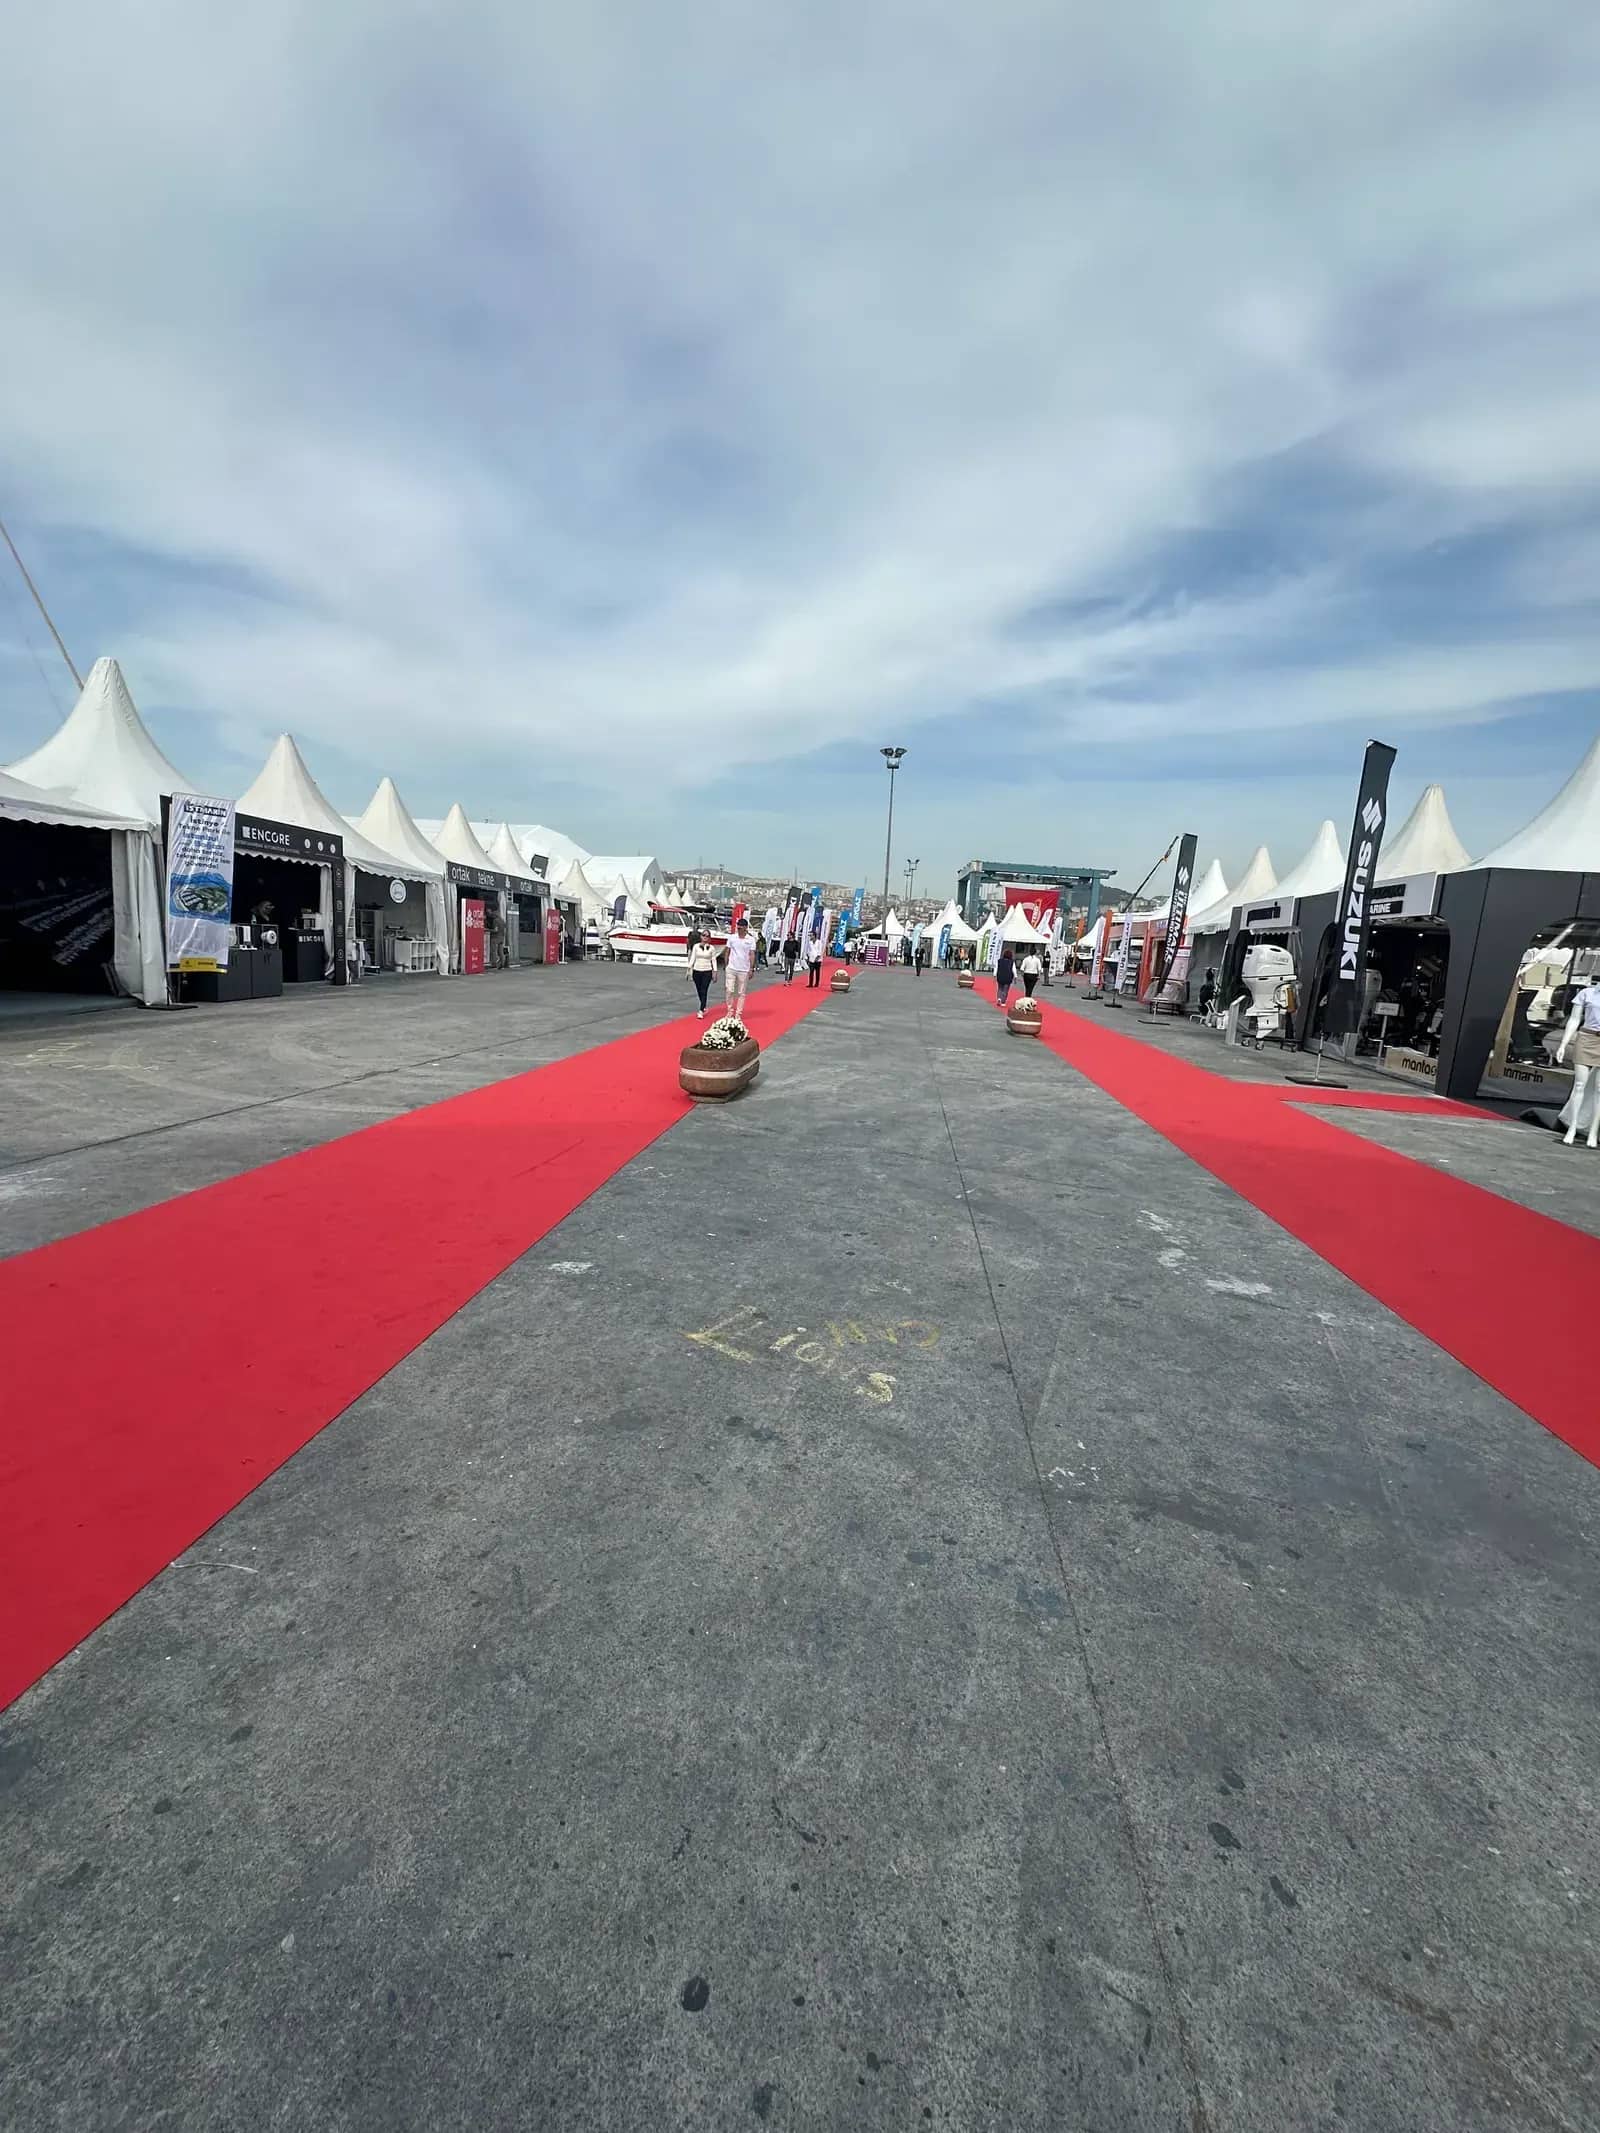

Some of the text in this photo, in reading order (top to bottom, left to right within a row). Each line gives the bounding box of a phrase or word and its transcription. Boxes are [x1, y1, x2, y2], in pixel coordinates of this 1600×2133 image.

[251, 828, 290, 846] ENCORE
[451, 866, 495, 887] ortak tekne
[1340, 840, 1372, 980] SUZUKI
[1370, 903, 1391, 914] ARINE
[838, 919, 847, 945] AYGAZ
[1166, 889, 1185, 961] ULTIMATE
